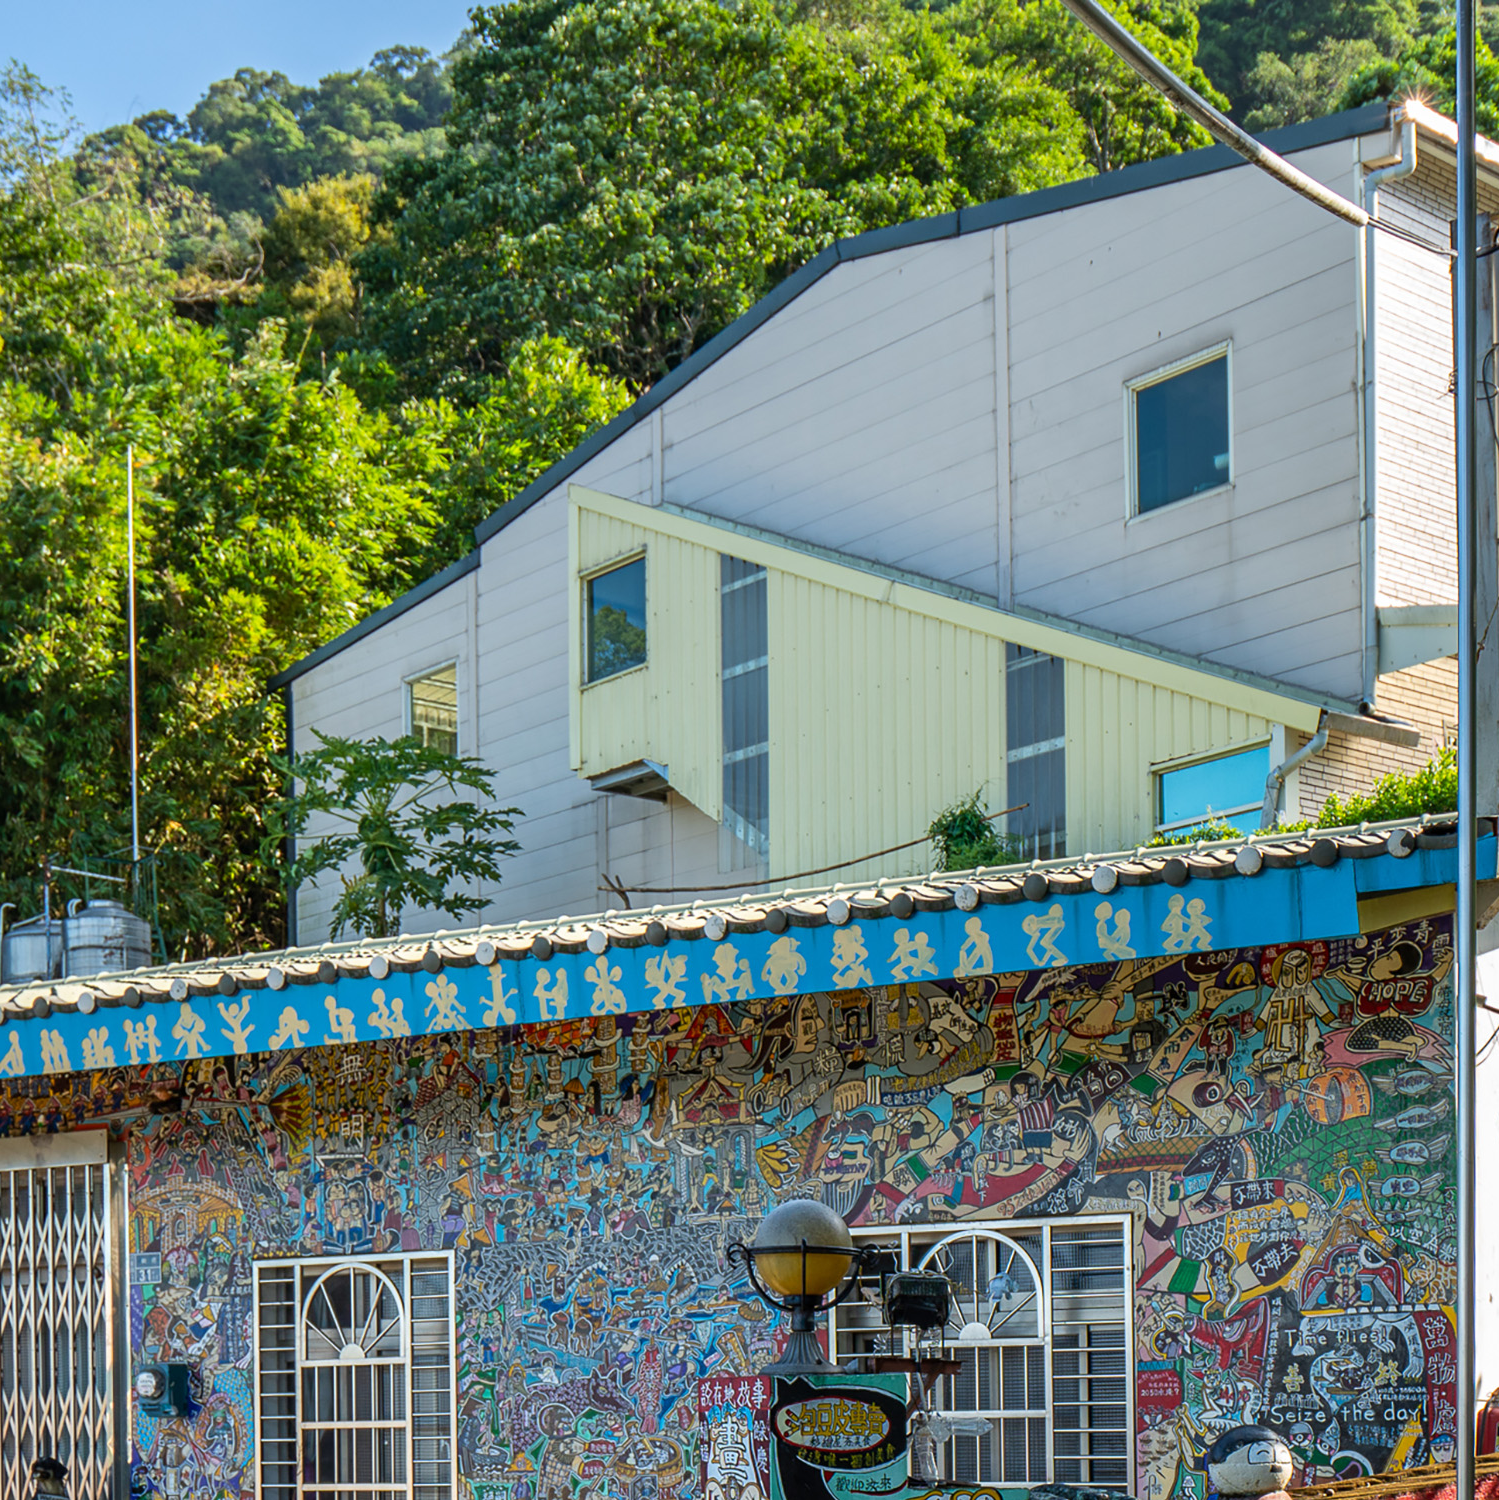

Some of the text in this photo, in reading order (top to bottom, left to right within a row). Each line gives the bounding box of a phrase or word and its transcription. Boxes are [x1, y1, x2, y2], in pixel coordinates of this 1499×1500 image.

[1368, 980, 1429, 1003] HOPE
[1234, 1180, 1276, 1205] 不帶來
[1252, 1242, 1299, 1277] 不帶去
[1284, 1326, 1387, 1347] Time flies!
[1270, 1400, 1429, 1424] Seize the day!
